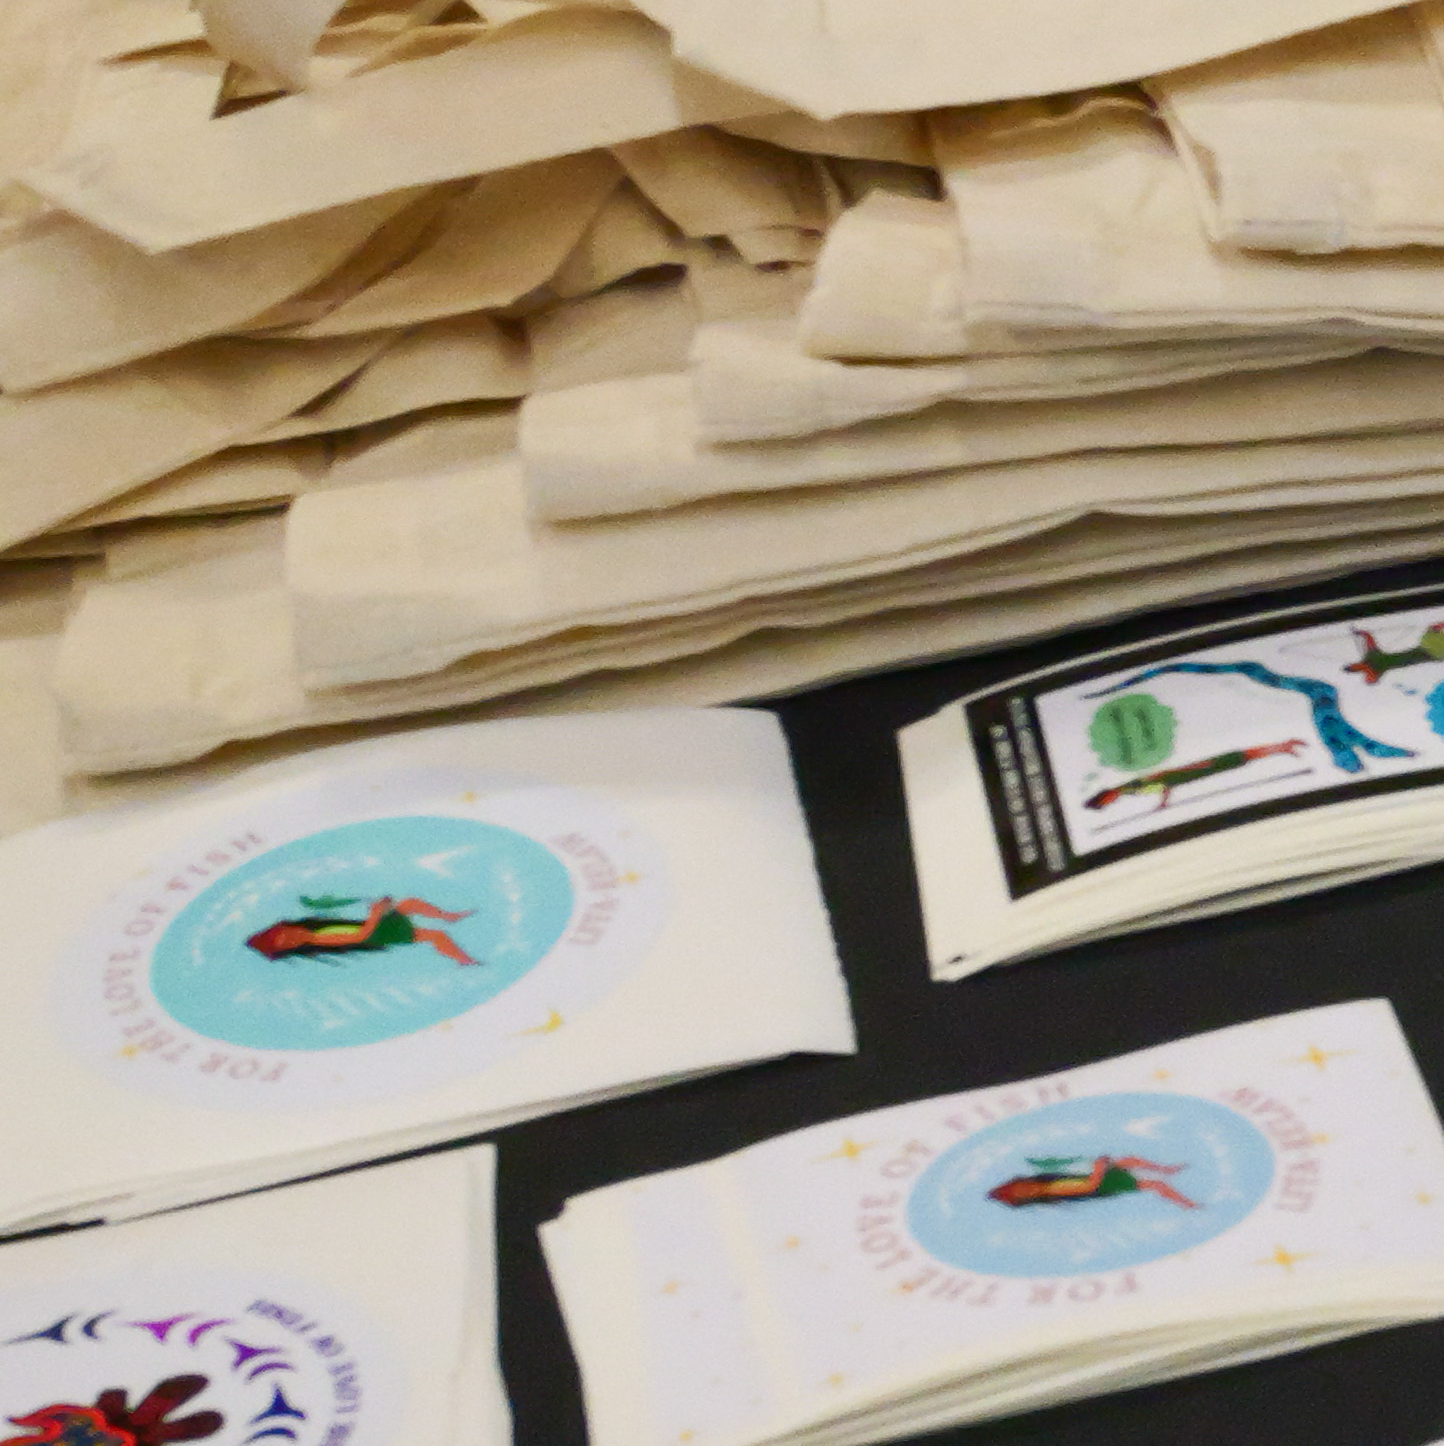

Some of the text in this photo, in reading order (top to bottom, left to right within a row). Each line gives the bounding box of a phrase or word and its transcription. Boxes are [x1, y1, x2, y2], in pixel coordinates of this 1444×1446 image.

[102, 946, 144, 1017] LOVE
[199, 1051, 288, 1082] FOR
[856, 1191, 912, 1271] LOVE
[1026, 1271, 1139, 1305] FOR
